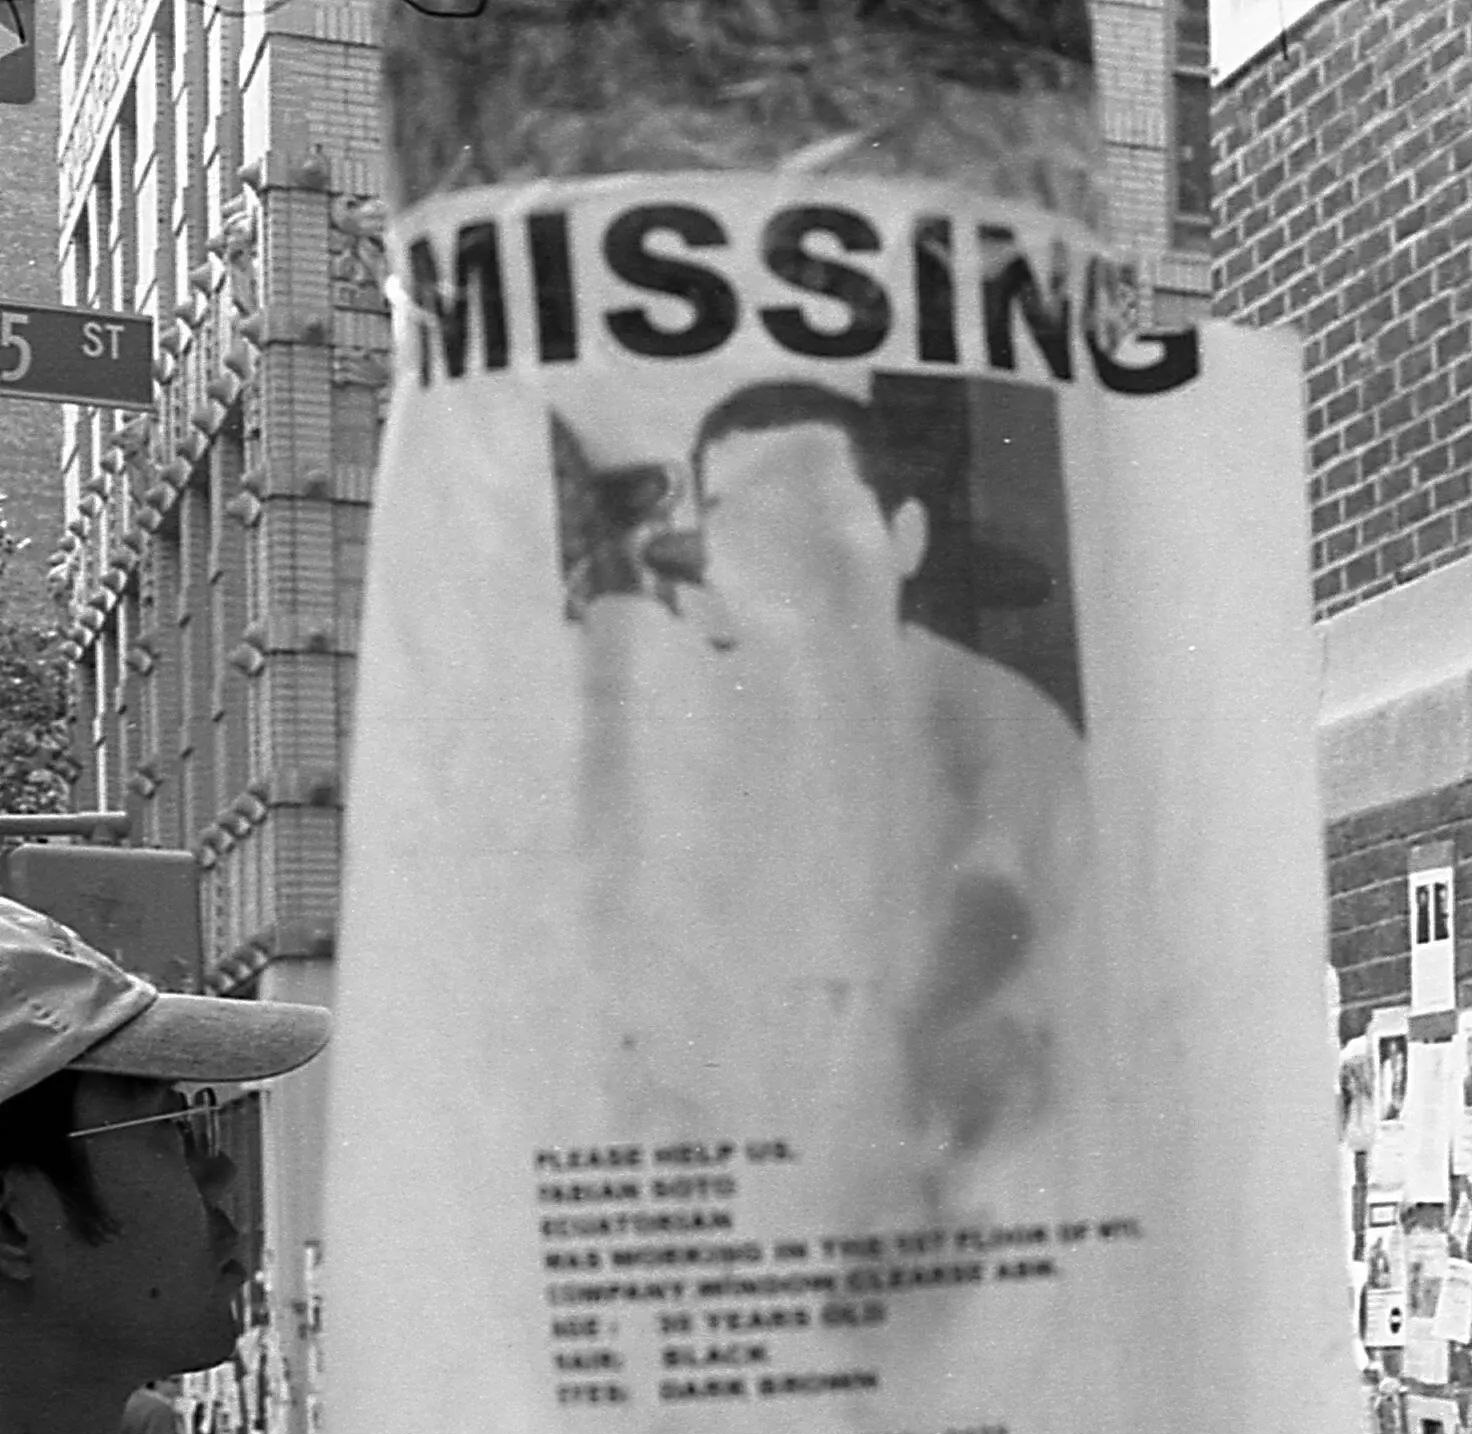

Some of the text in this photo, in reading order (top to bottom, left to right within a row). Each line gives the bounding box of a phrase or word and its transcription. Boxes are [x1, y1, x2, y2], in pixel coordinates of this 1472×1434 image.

[407, 203, 1200, 396] MISSING
[81, 323, 125, 359] ST
[536, 1143, 642, 1170] PLEASE
[652, 1141, 735, 1167] HELP
[611, 1242, 763, 1267] WORKING
[545, 1278, 686, 1305] COMPANY
[705, 1306, 813, 1334] YEARS
[661, 1343, 769, 1370] BLACK
[757, 1367, 878, 1397] BROWN
